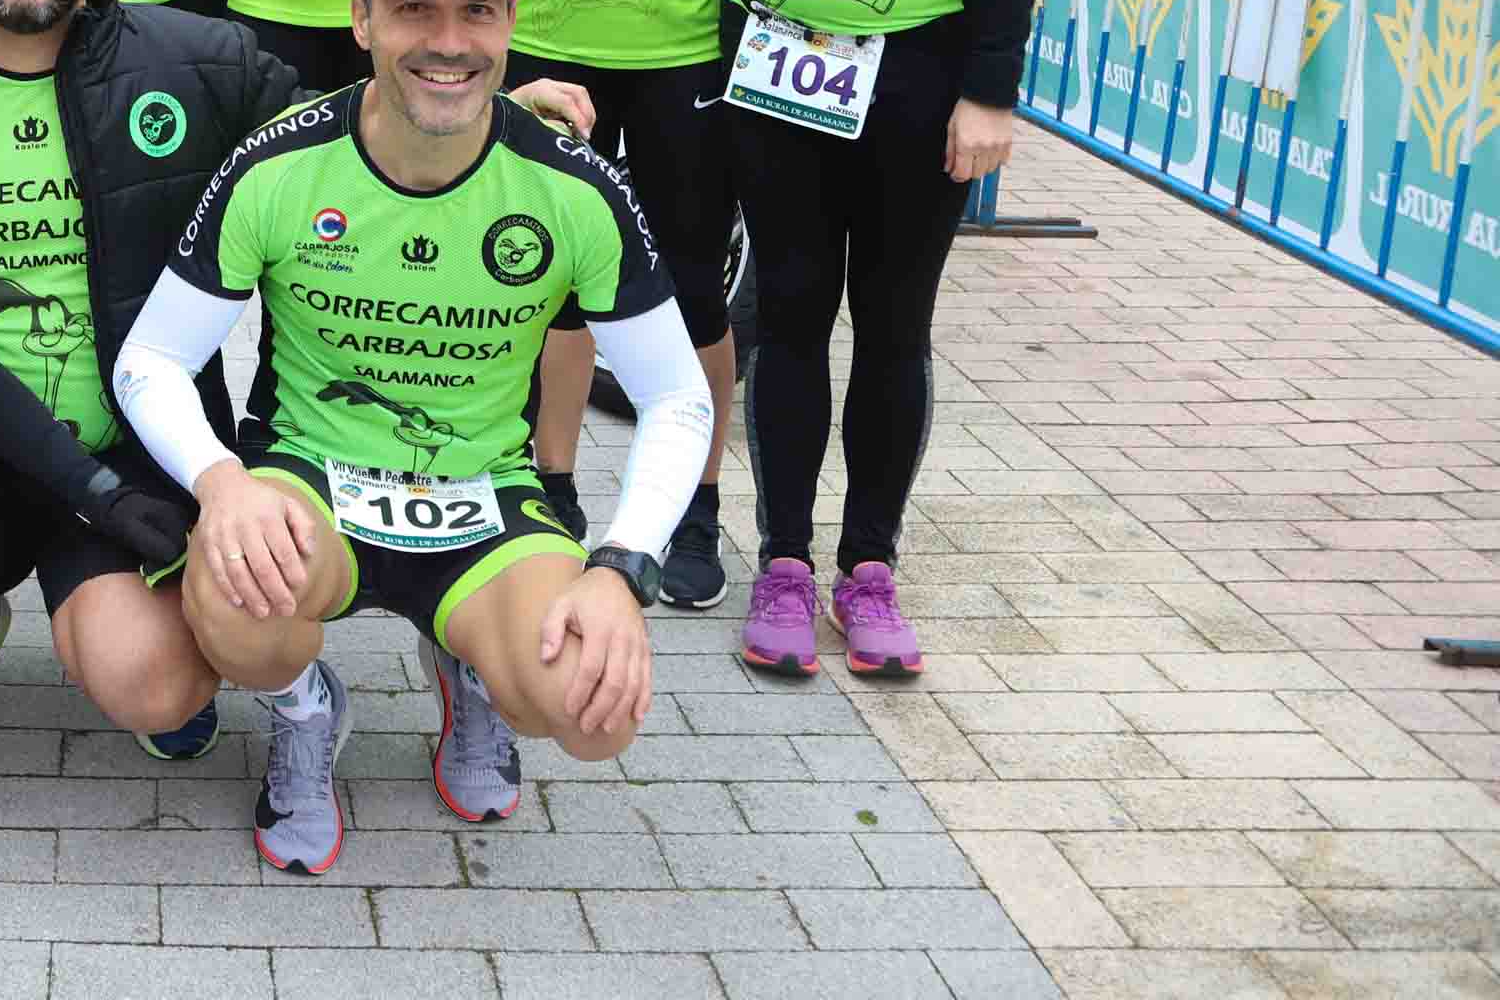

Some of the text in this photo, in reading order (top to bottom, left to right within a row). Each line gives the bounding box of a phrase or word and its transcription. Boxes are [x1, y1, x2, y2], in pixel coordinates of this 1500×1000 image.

[768, 46, 858, 106] 104
[746, 94, 765, 106] CAJA
[766, 99, 789, 114] RURAL
[800, 108, 855, 131] SALAMANCA
[178, 102, 334, 257] CORRECAMINOS
[295, 242, 359, 254] CARBAJOSA
[288, 282, 549, 330] CORRECAMINOS
[316, 327, 513, 361] CARBAJOSA
[353, 365, 476, 387] SALAMANCA
[332, 460, 345, 473] VII
[346, 474, 397, 490] Salamanca
[368, 496, 486, 530] 102
[358, 528, 383, 542] CAJA
[385, 536, 416, 547] RURAL
[432, 528, 498, 546] SALAMANCA
